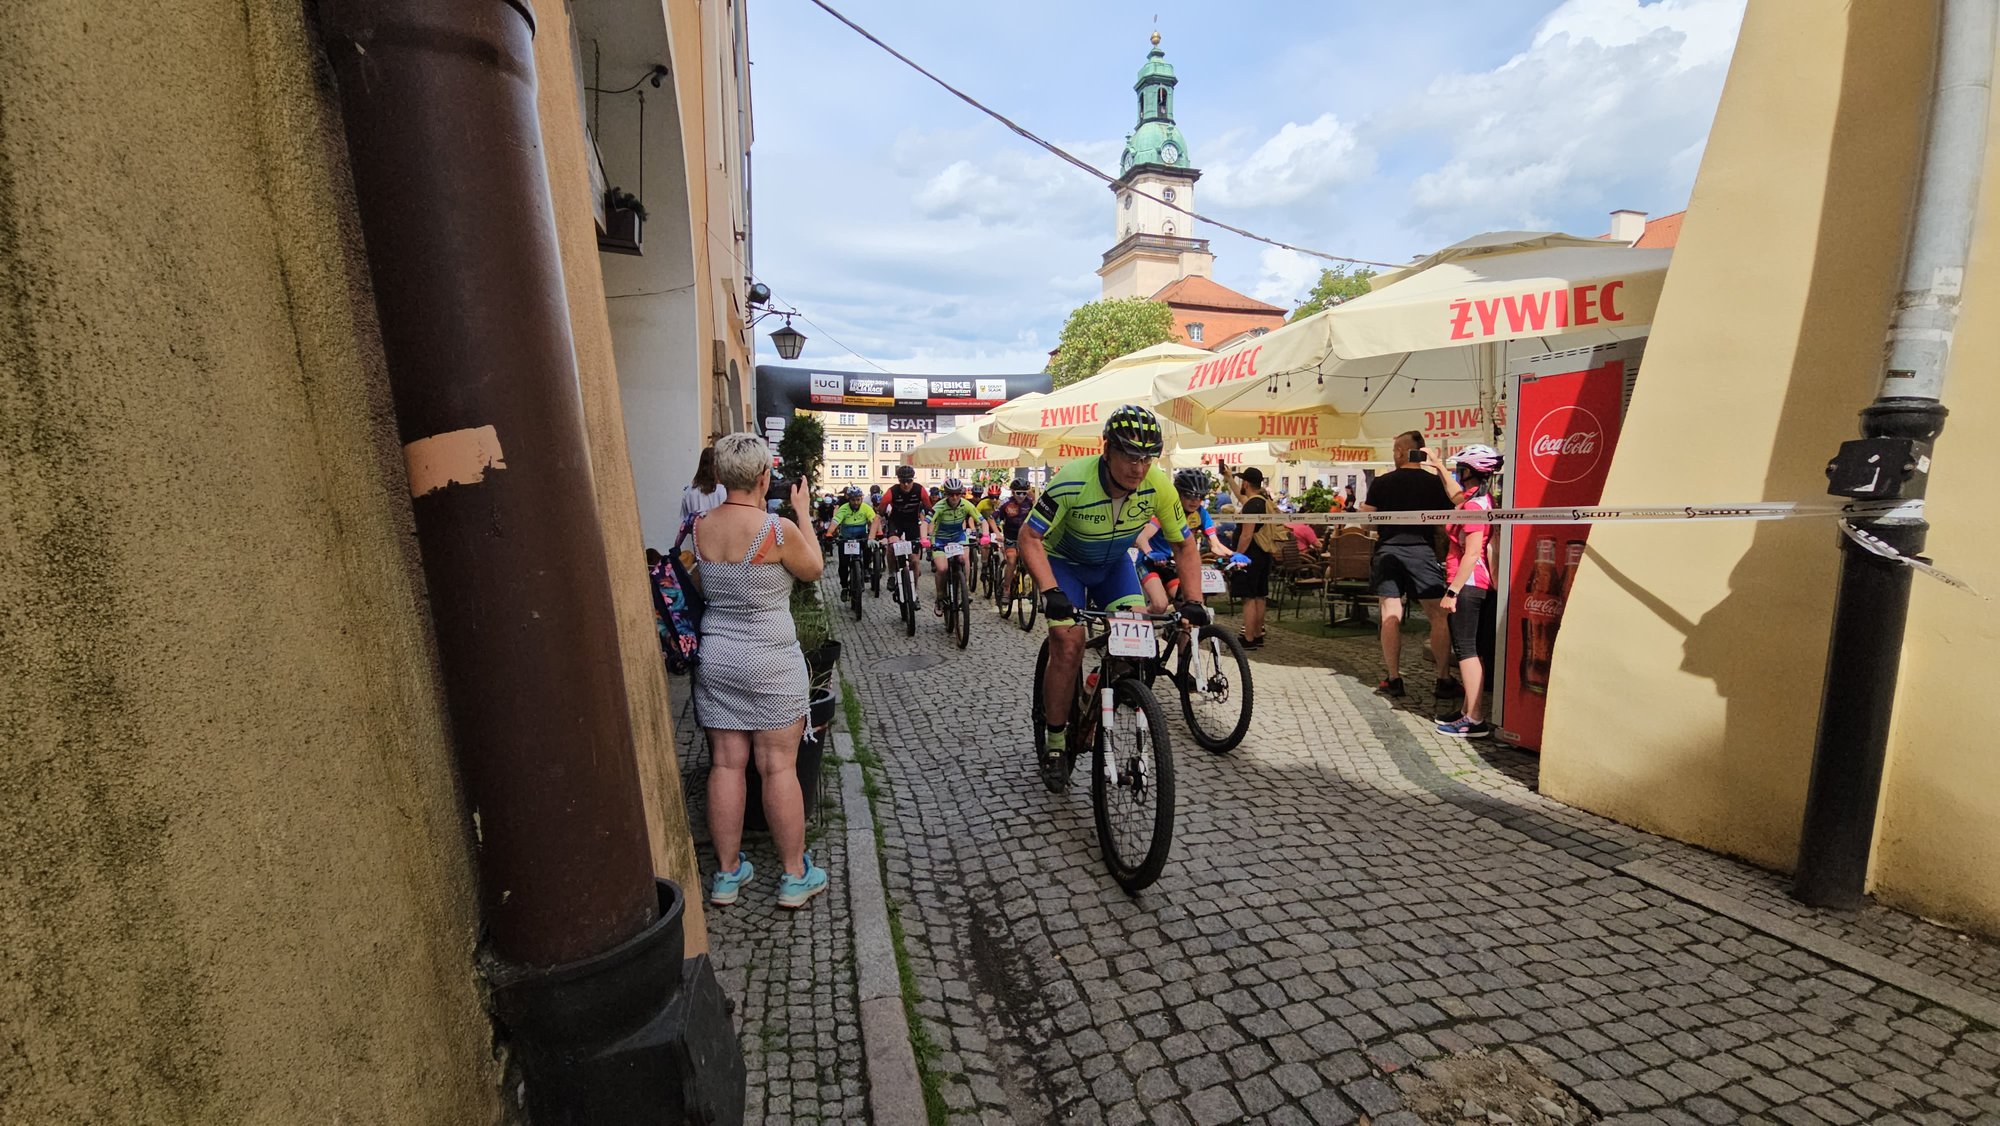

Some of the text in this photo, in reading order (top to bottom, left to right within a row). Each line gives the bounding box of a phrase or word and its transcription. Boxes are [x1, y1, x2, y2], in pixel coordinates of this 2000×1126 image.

[1449, 280, 1624, 340] ŻYWIEC
[1187, 345, 1262, 391] ŻYWIEC
[819, 380, 839, 389] UCI
[943, 381, 971, 389] BIKE
[1041, 402, 1099, 428] ŻYWIEC
[890, 418, 934, 430] START
[1533, 431, 1599, 456] Coca-Cola
[949, 447, 988, 462] ŻYWIEC
[1072, 511, 1106, 524] Energo
[1203, 571, 1217, 580] 98
[1112, 623, 1150, 638] 1717
